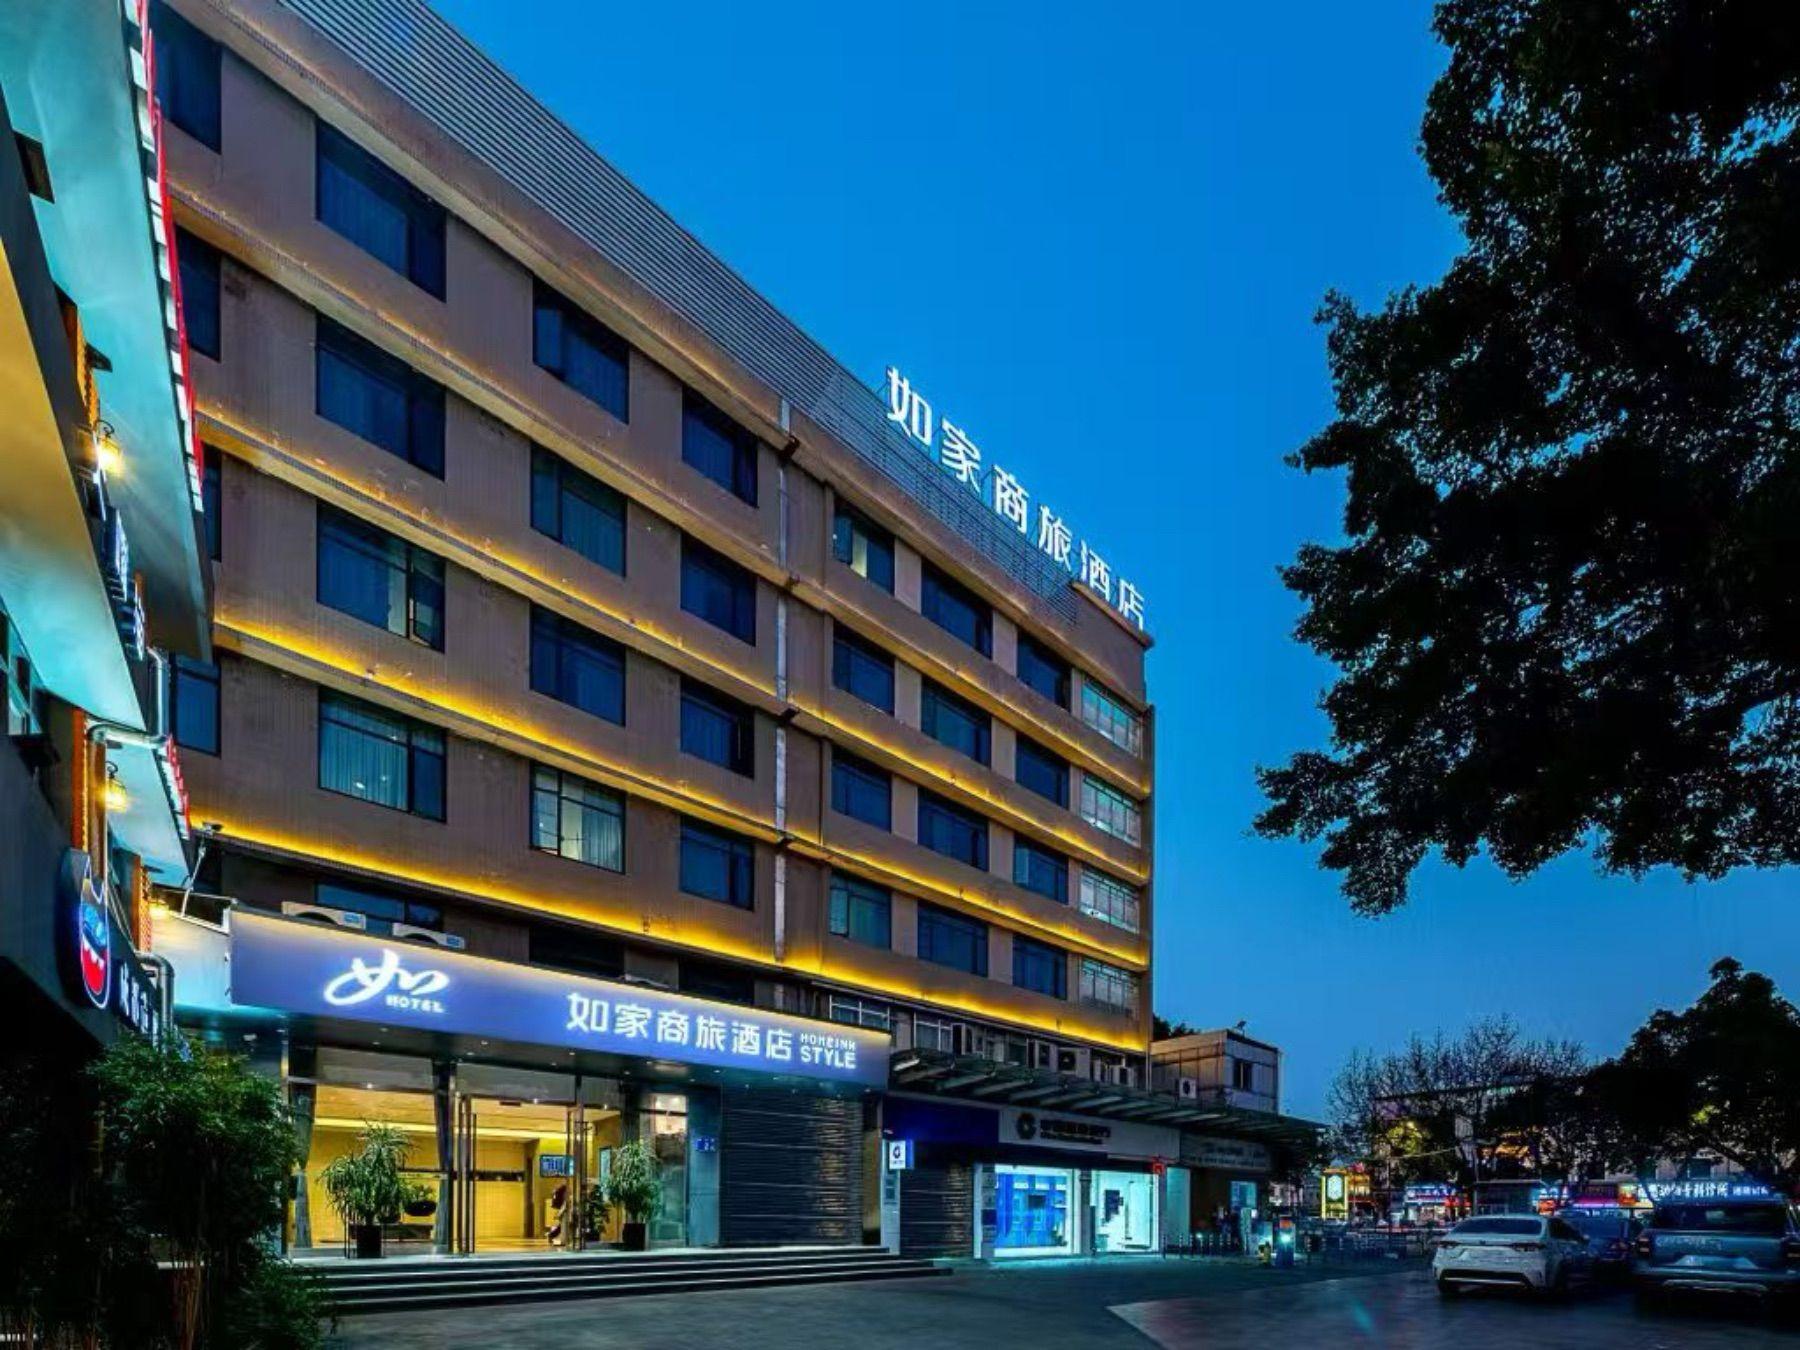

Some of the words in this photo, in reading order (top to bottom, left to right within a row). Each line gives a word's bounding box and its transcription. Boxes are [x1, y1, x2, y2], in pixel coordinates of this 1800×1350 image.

[886, 366, 1145, 630] 如家商旅酒店
[386, 994, 444, 1013] HOTEL
[566, 992, 793, 1061] 如家商旅酒店
[800, 1045, 857, 1069] STYLE
